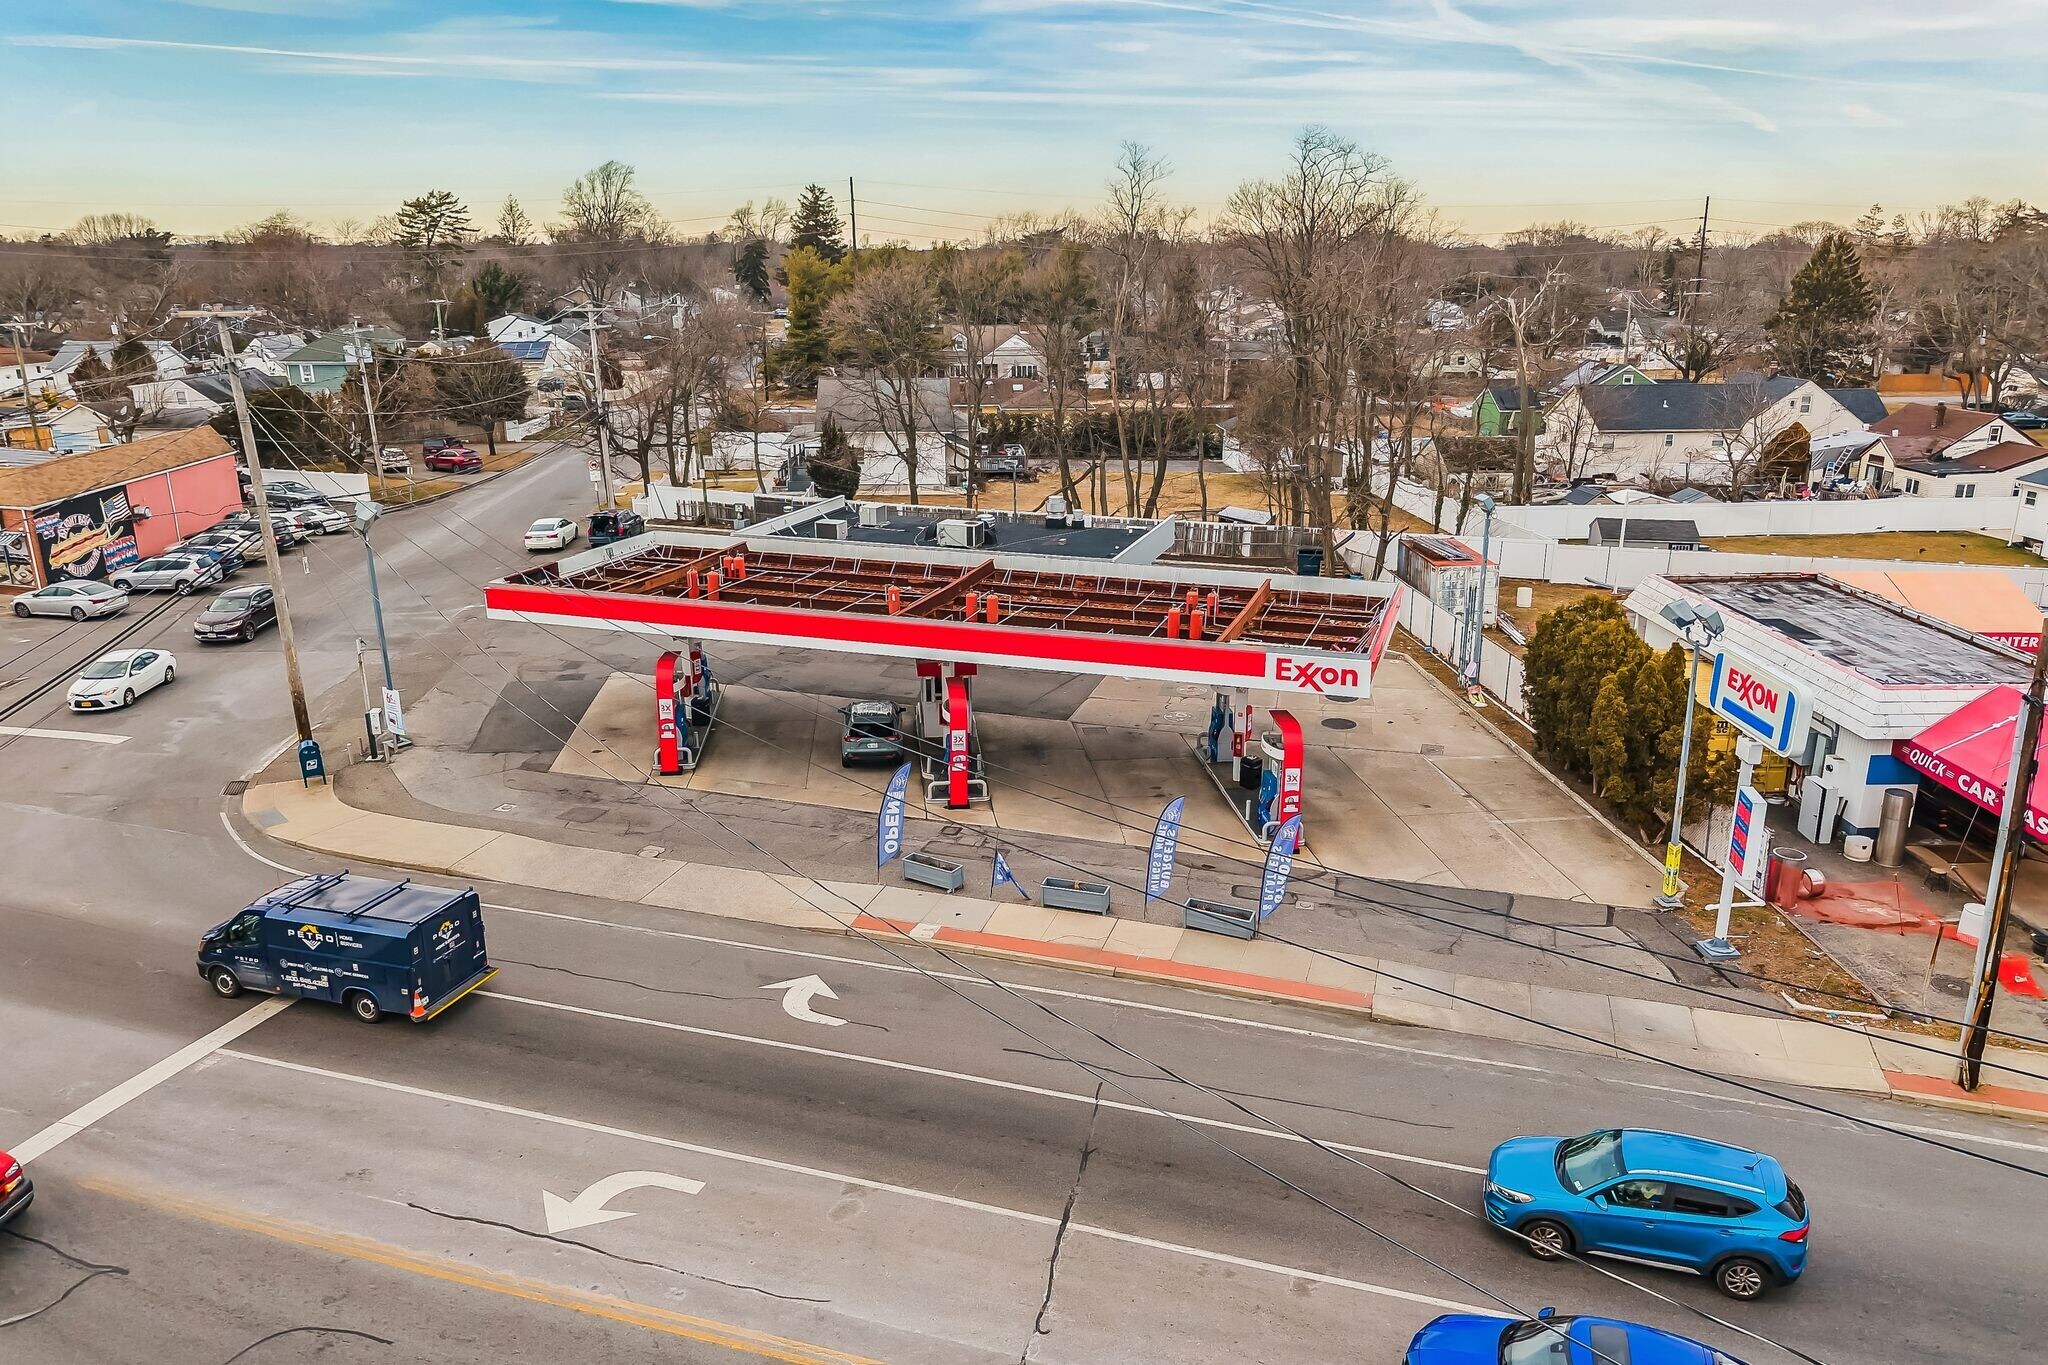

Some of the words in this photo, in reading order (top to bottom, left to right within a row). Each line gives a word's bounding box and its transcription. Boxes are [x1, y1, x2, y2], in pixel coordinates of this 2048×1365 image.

[1276, 658, 1359, 692] Exxon
[1727, 667, 1779, 714] EXXON
[660, 704, 671, 712] 3X
[953, 735, 964, 744] 3X
[1286, 774, 1298, 783] 3X
[1909, 748, 1947, 778] QUICK
[1957, 774, 2000, 808] CAR
[287, 929, 334, 943] PETRO
[432, 920, 460, 940] PETRO
